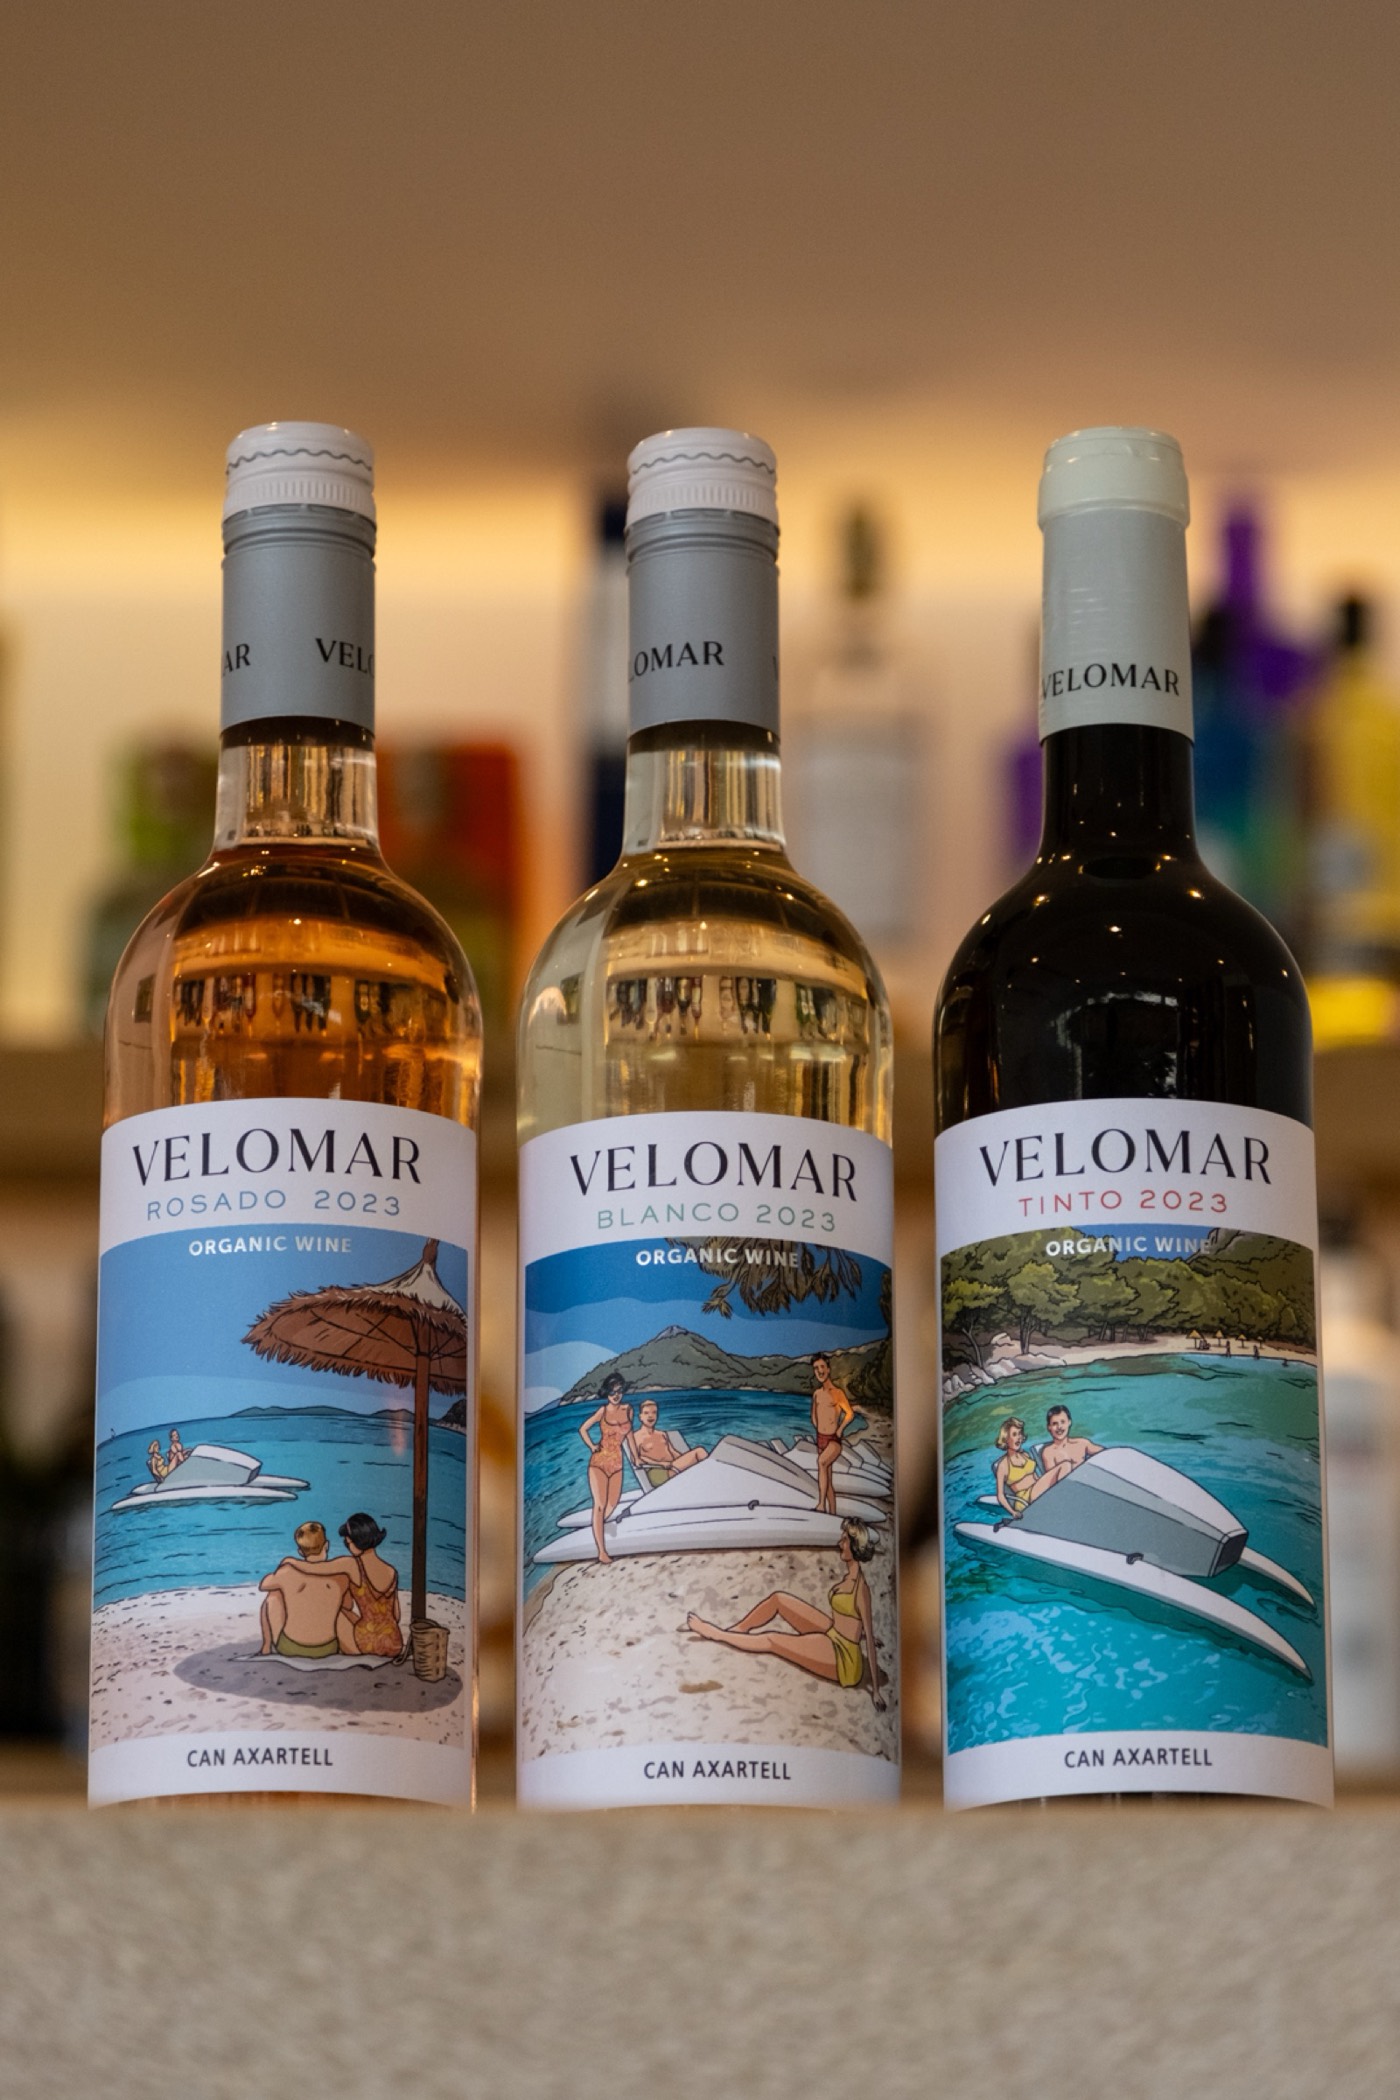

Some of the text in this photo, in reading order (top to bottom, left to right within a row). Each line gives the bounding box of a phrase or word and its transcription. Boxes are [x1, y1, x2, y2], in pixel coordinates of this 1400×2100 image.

[1042, 662, 1180, 700] VELOMAR
[132, 1128, 421, 1186] VELOMAR
[979, 1128, 1272, 1186] VELOMAR
[570, 1141, 857, 1202] VELOMAR
[146, 1189, 401, 1221] ROSADO 2023
[1018, 1189, 1228, 1217] TINTO 2023
[598, 1203, 836, 1233] BLANCO 2023
[188, 1235, 352, 1256] ORGANIC WINE
[635, 1248, 799, 1269] ORGANIC WINE
[1045, 1236, 1211, 1256] ORGANIC WINE
[187, 1747, 334, 1768] CAN AXARTELL
[643, 1760, 792, 1780] CAN AXARTELL
[1063, 1747, 1213, 1768] CAN AXARTELL
